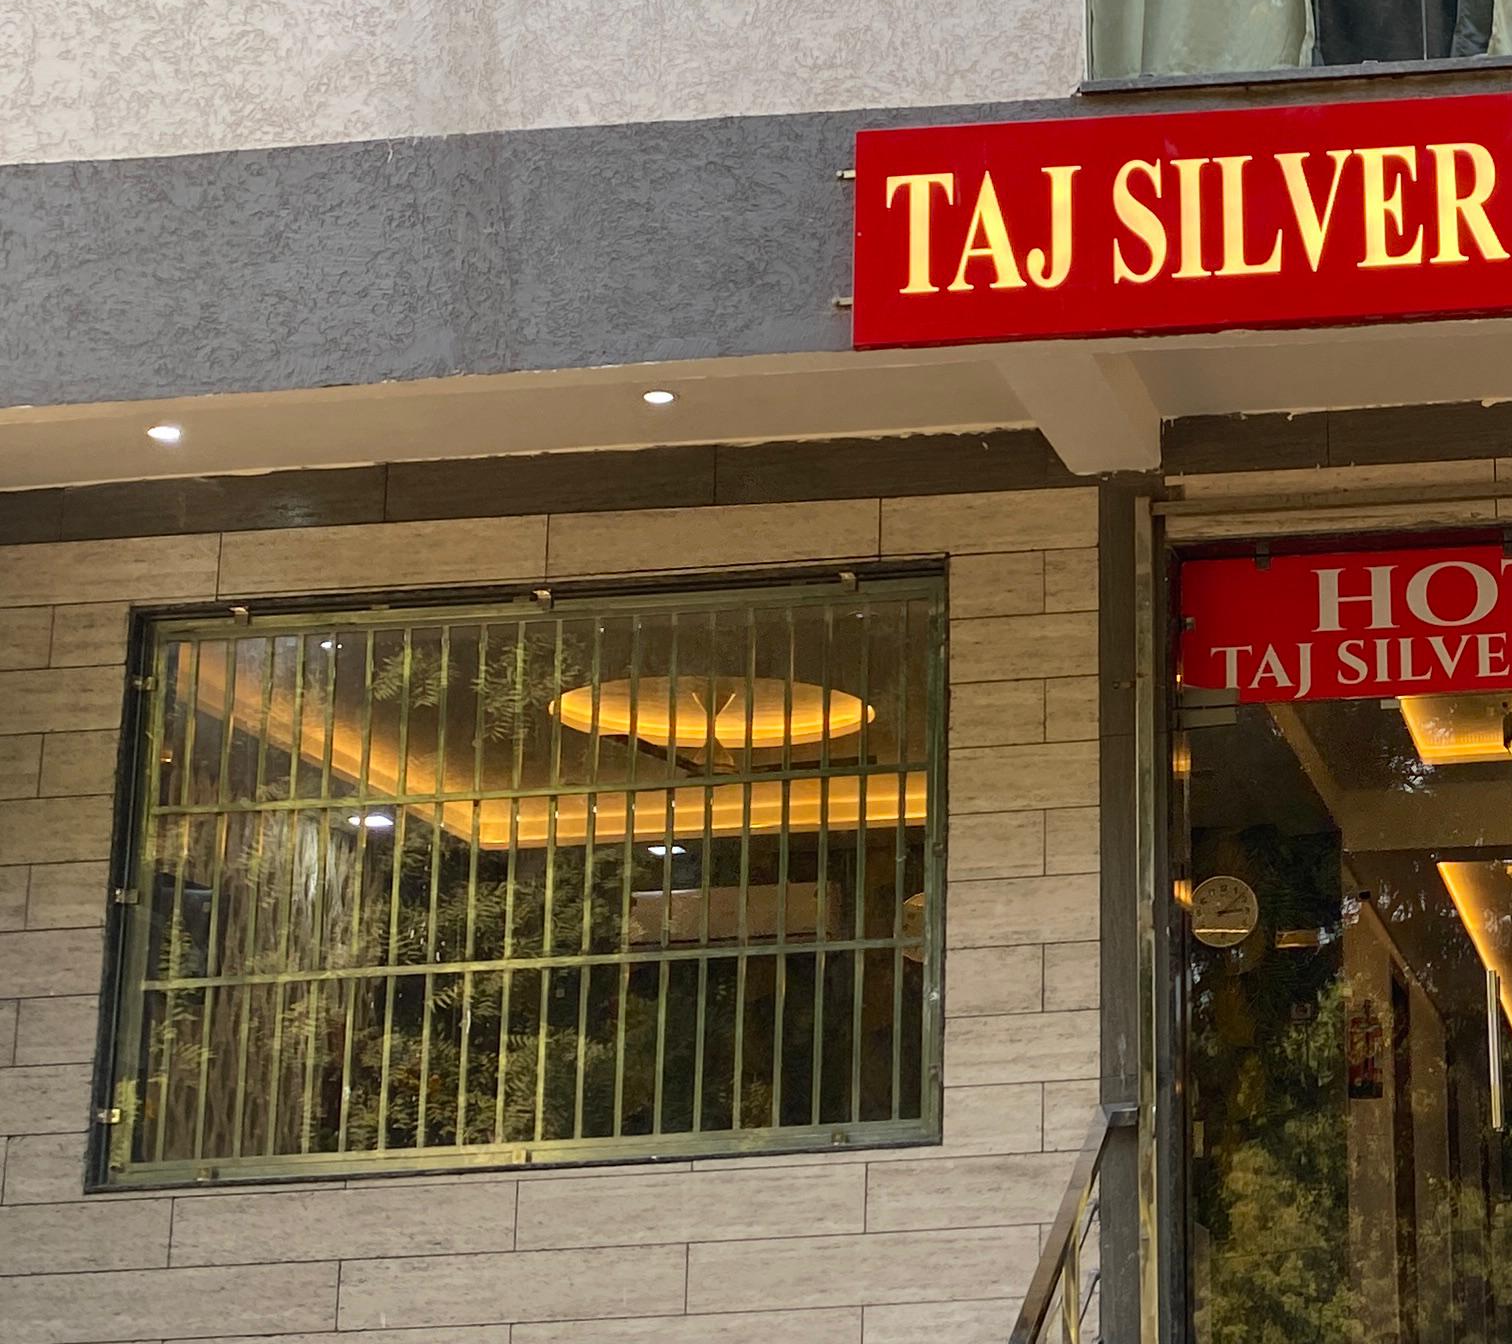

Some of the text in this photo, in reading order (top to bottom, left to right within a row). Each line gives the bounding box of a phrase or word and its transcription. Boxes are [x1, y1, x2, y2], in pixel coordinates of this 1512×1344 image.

[885, 165, 1082, 294] TAJ
[1112, 142, 1511, 284] SILVER
[1211, 643, 1313, 699] TAJ
